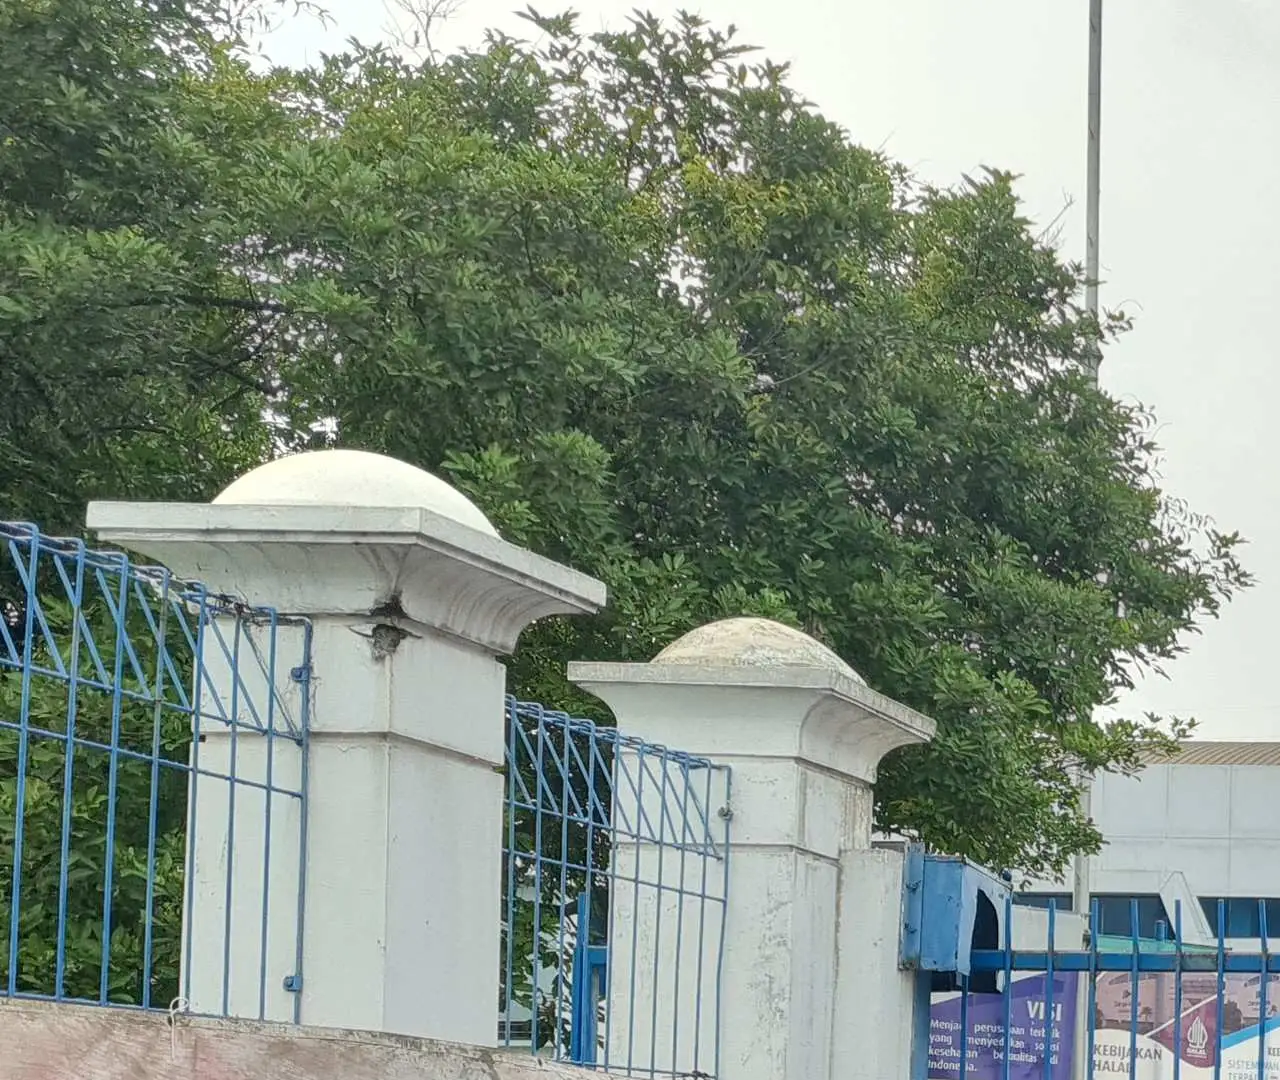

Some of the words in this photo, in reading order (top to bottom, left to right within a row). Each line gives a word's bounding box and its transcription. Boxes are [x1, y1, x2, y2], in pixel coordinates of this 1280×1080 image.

[930, 1019, 962, 1032] Menja
[974, 1023, 1025, 1035] perusaan
[1030, 1026, 1060, 1038] terik
[929, 1033, 952, 1046] yang
[967, 1036, 1025, 1049] menyedkan
[1034, 1042, 1060, 1052] sosi
[928, 1045, 978, 1059] kesehaan
[993, 1049, 1037, 1063] beualitas
[1050, 1053, 1058, 1065] di
[928, 1059, 978, 1072] Indoneia.
